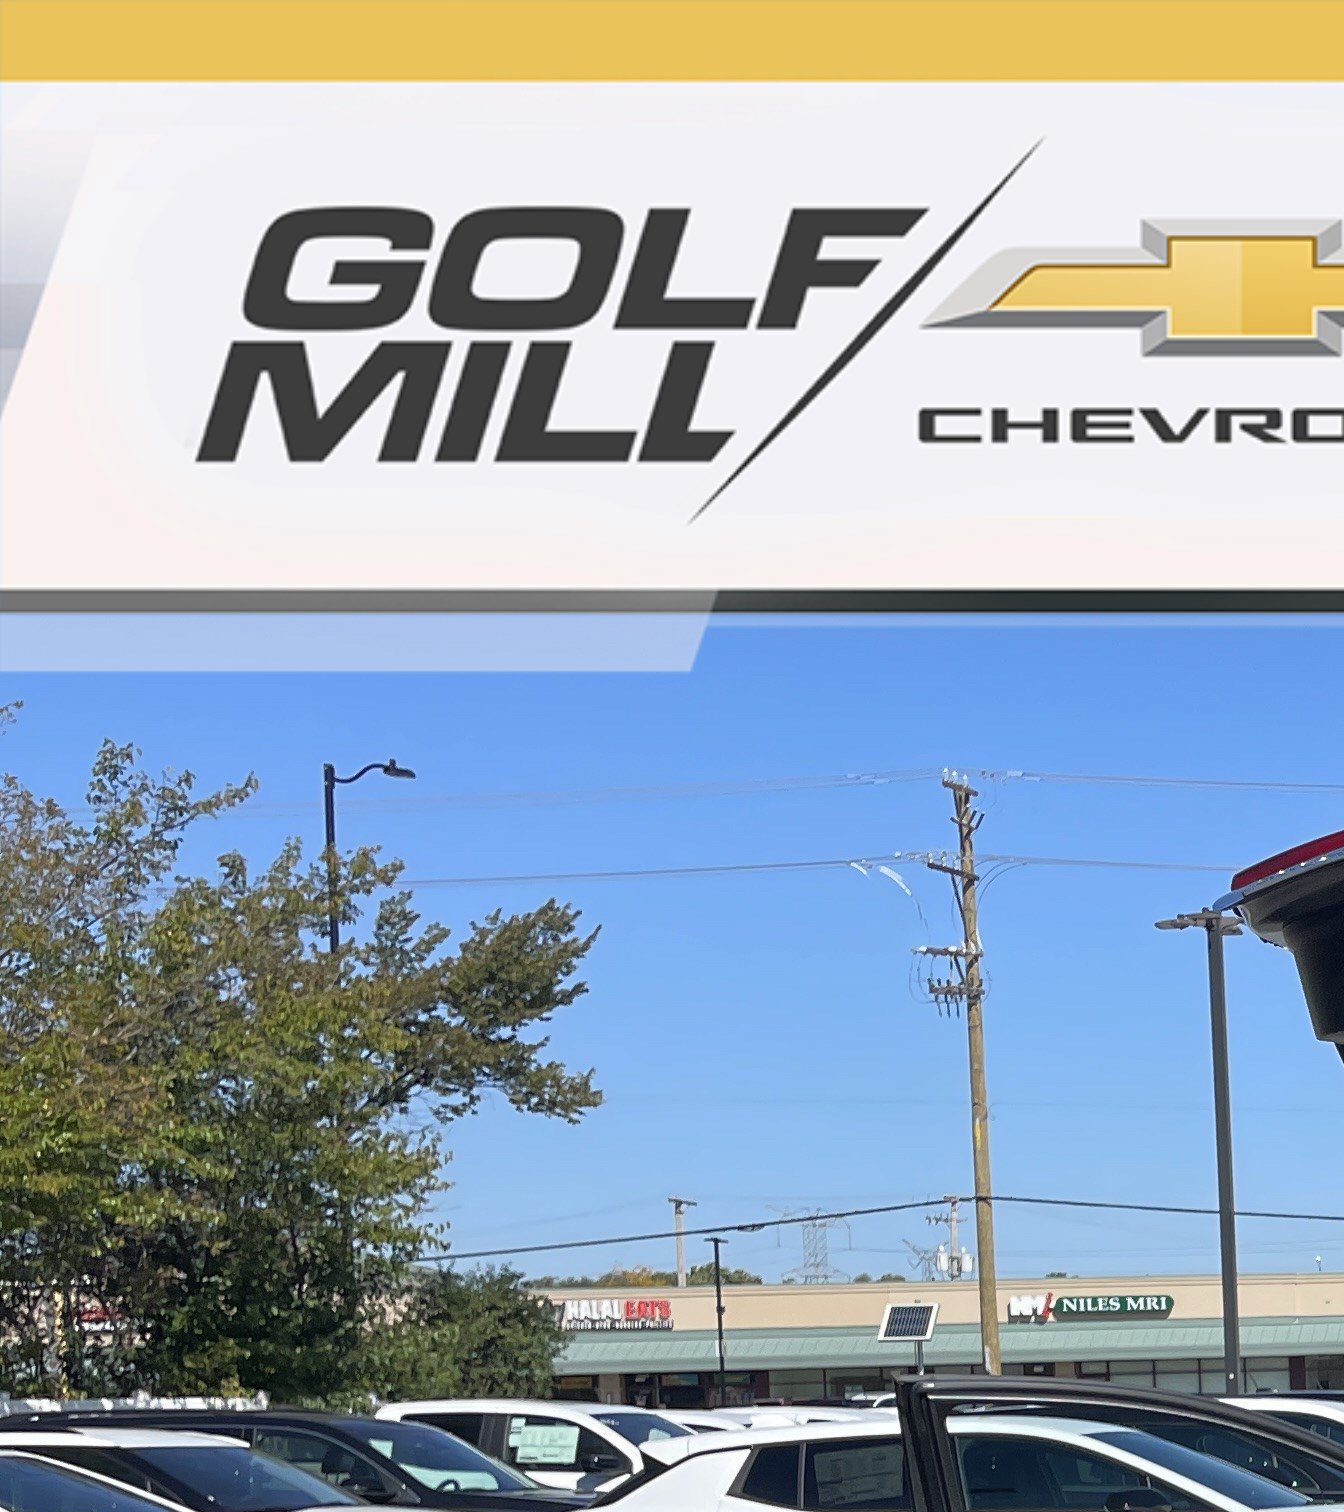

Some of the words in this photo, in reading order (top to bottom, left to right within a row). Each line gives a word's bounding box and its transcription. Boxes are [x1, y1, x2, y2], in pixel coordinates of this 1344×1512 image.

[565, 1299, 622, 1320] HALAL
[624, 1299, 672, 1319] EATS
[1062, 1296, 1121, 1313] NILES
[1126, 1295, 1167, 1311] MRI
